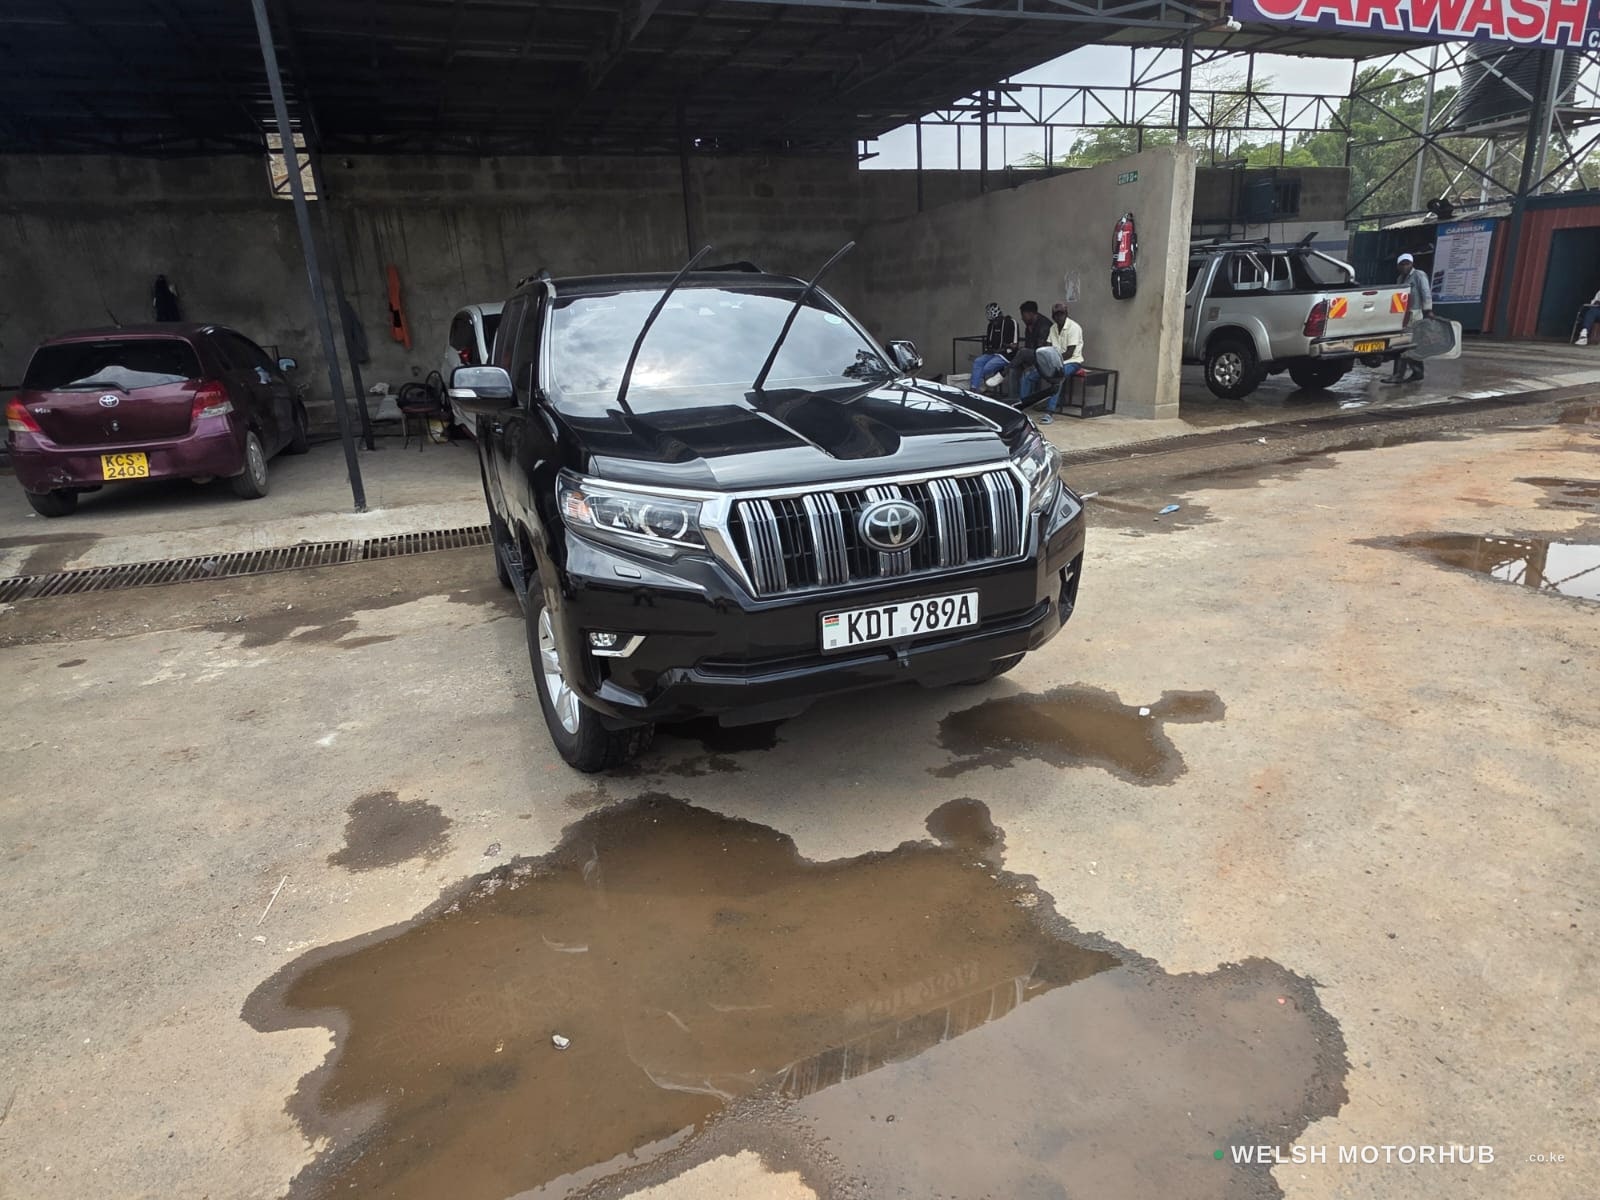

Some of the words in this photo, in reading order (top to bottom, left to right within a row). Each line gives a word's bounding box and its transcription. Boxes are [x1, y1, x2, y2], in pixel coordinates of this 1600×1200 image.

[1588, 31, 1600, 48] C
[105, 455, 135, 467] KCS
[107, 466, 145, 478] 240S
[848, 607, 898, 644] KDT
[910, 596, 971, 633] 989A
